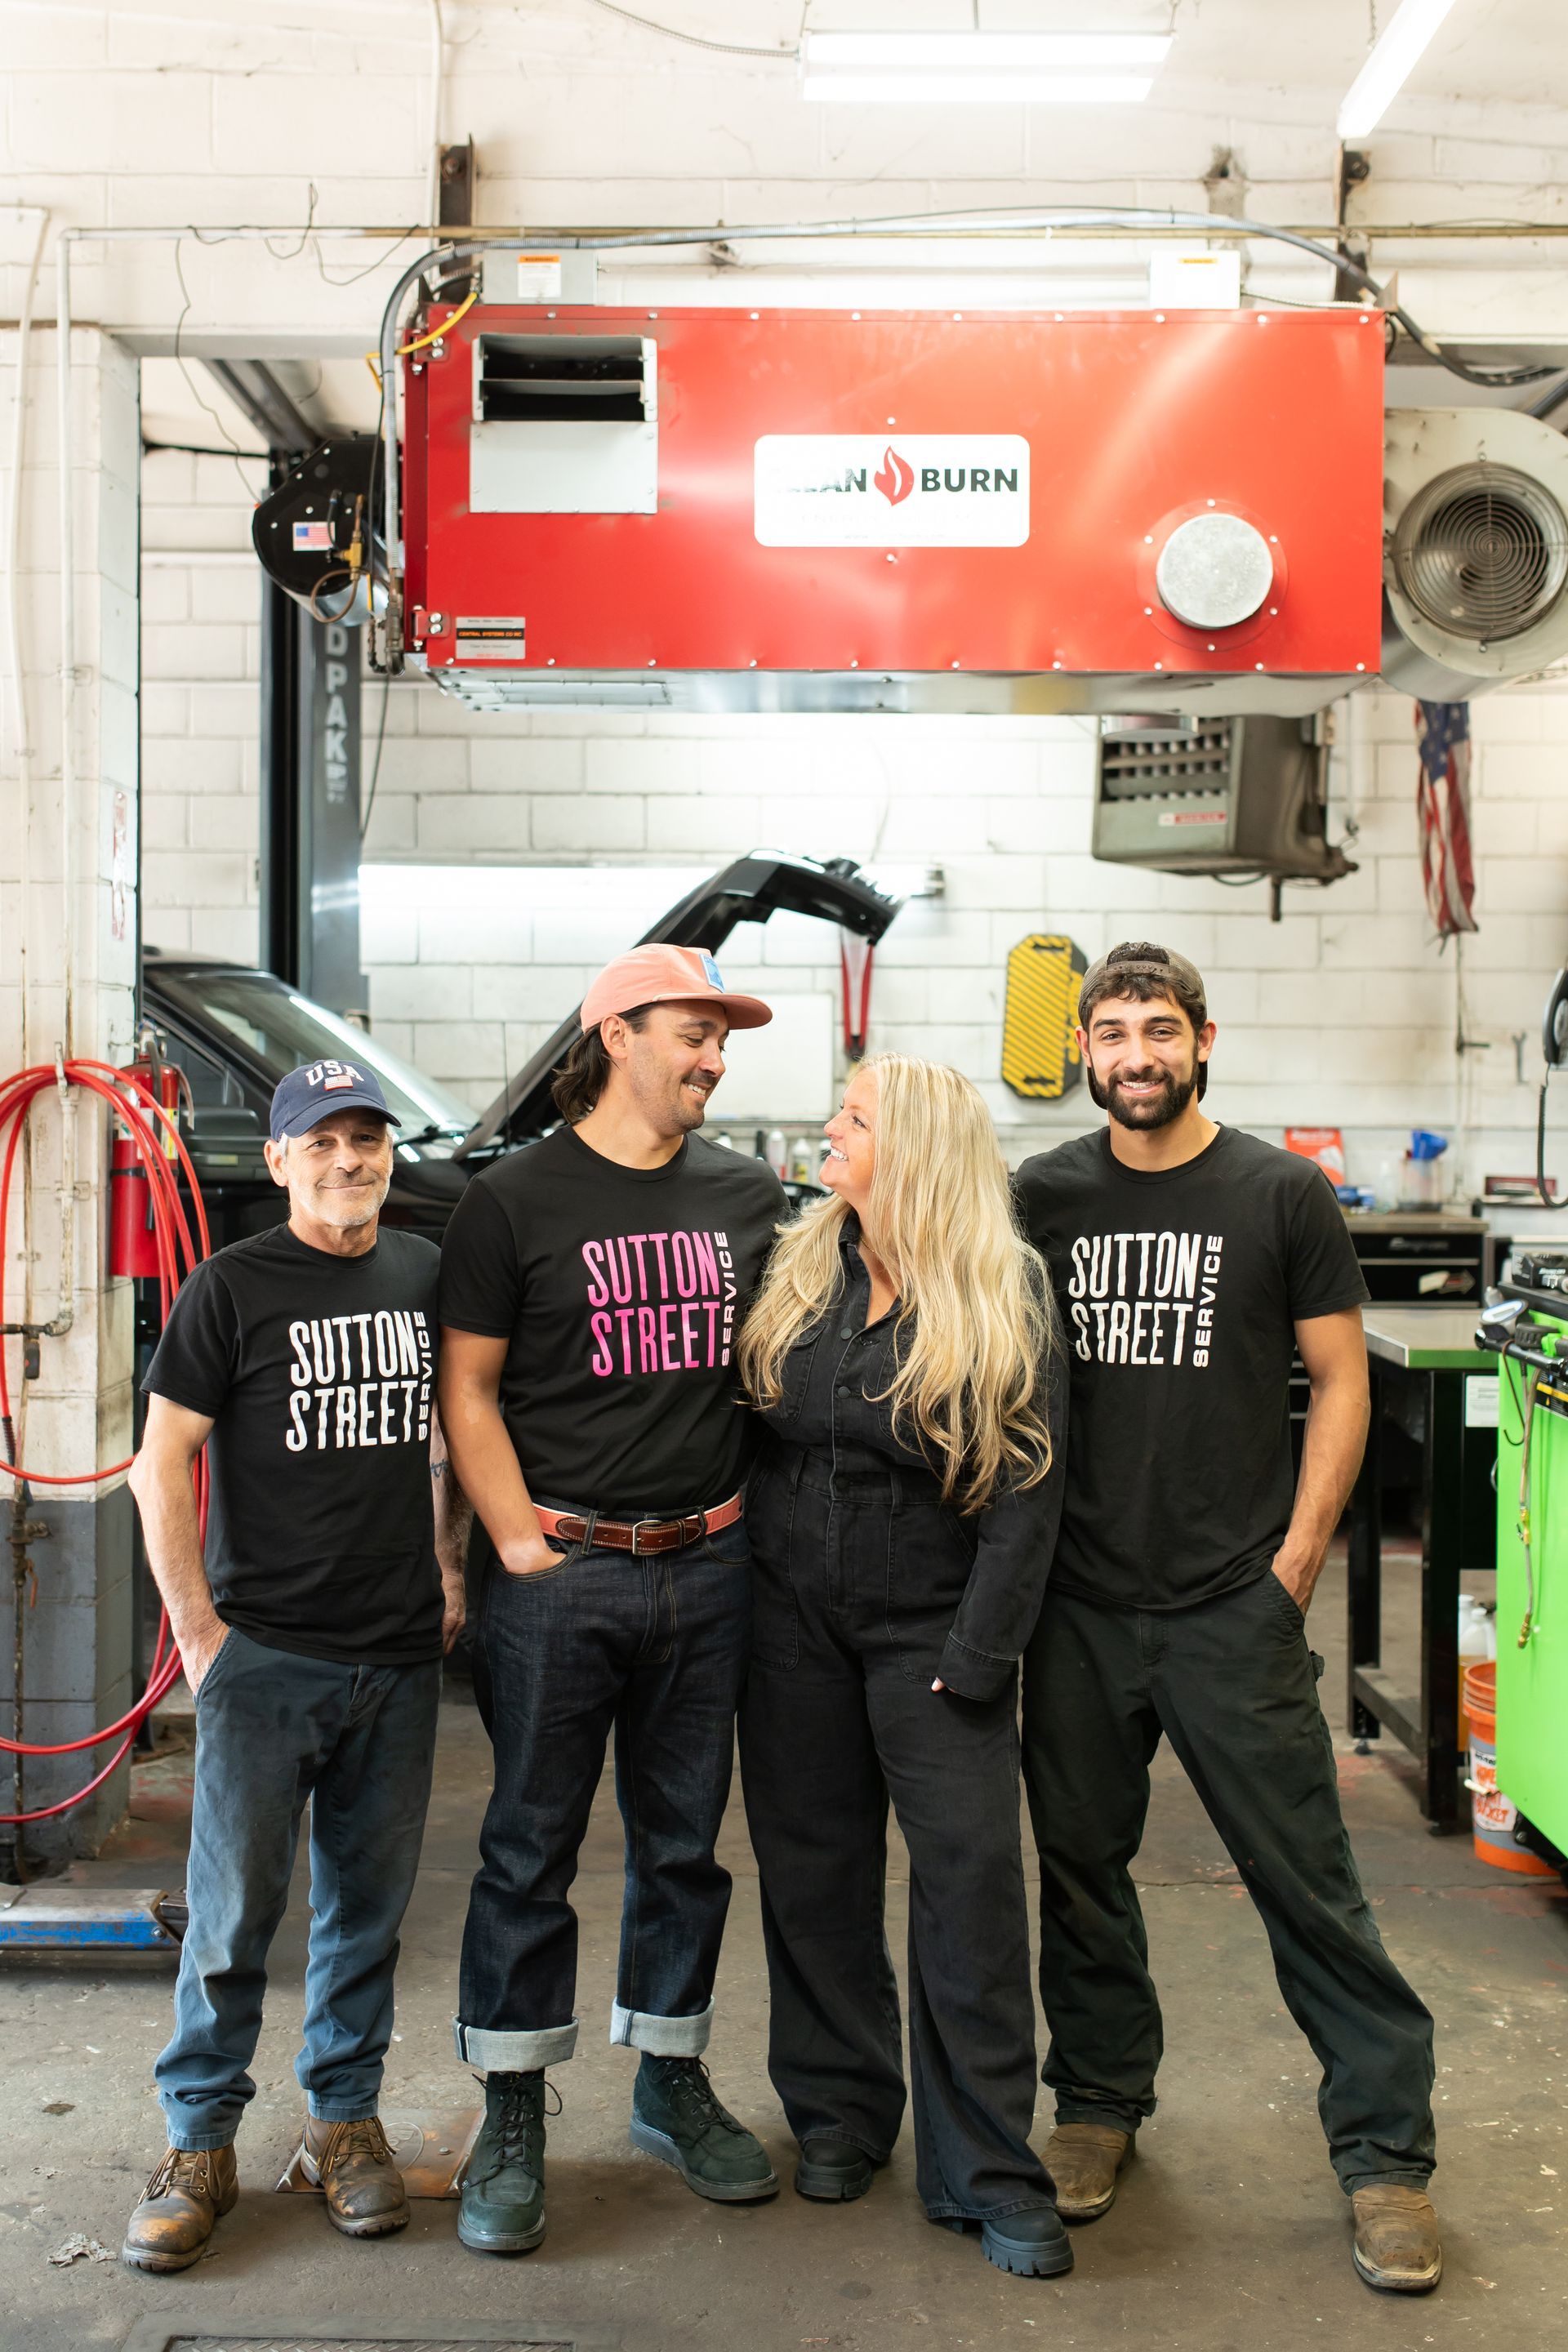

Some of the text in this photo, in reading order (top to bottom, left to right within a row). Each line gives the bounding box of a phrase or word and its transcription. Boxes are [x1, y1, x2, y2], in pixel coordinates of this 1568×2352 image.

[921, 469, 1018, 492] BURN
[305, 1061, 365, 1086] USA
[581, 1231, 719, 1307] SUTTON
[714, 1232, 737, 1366] SERVICE
[1068, 1232, 1202, 1298] SUTTON
[1192, 1235, 1223, 1368] SERVICE
[289, 1311, 419, 1387] SUTTON
[590, 1302, 720, 1377] STREET
[1071, 1301, 1193, 1365] STREET
[413, 1312, 433, 1441] SERVICE
[286, 1380, 418, 1451] STREET
